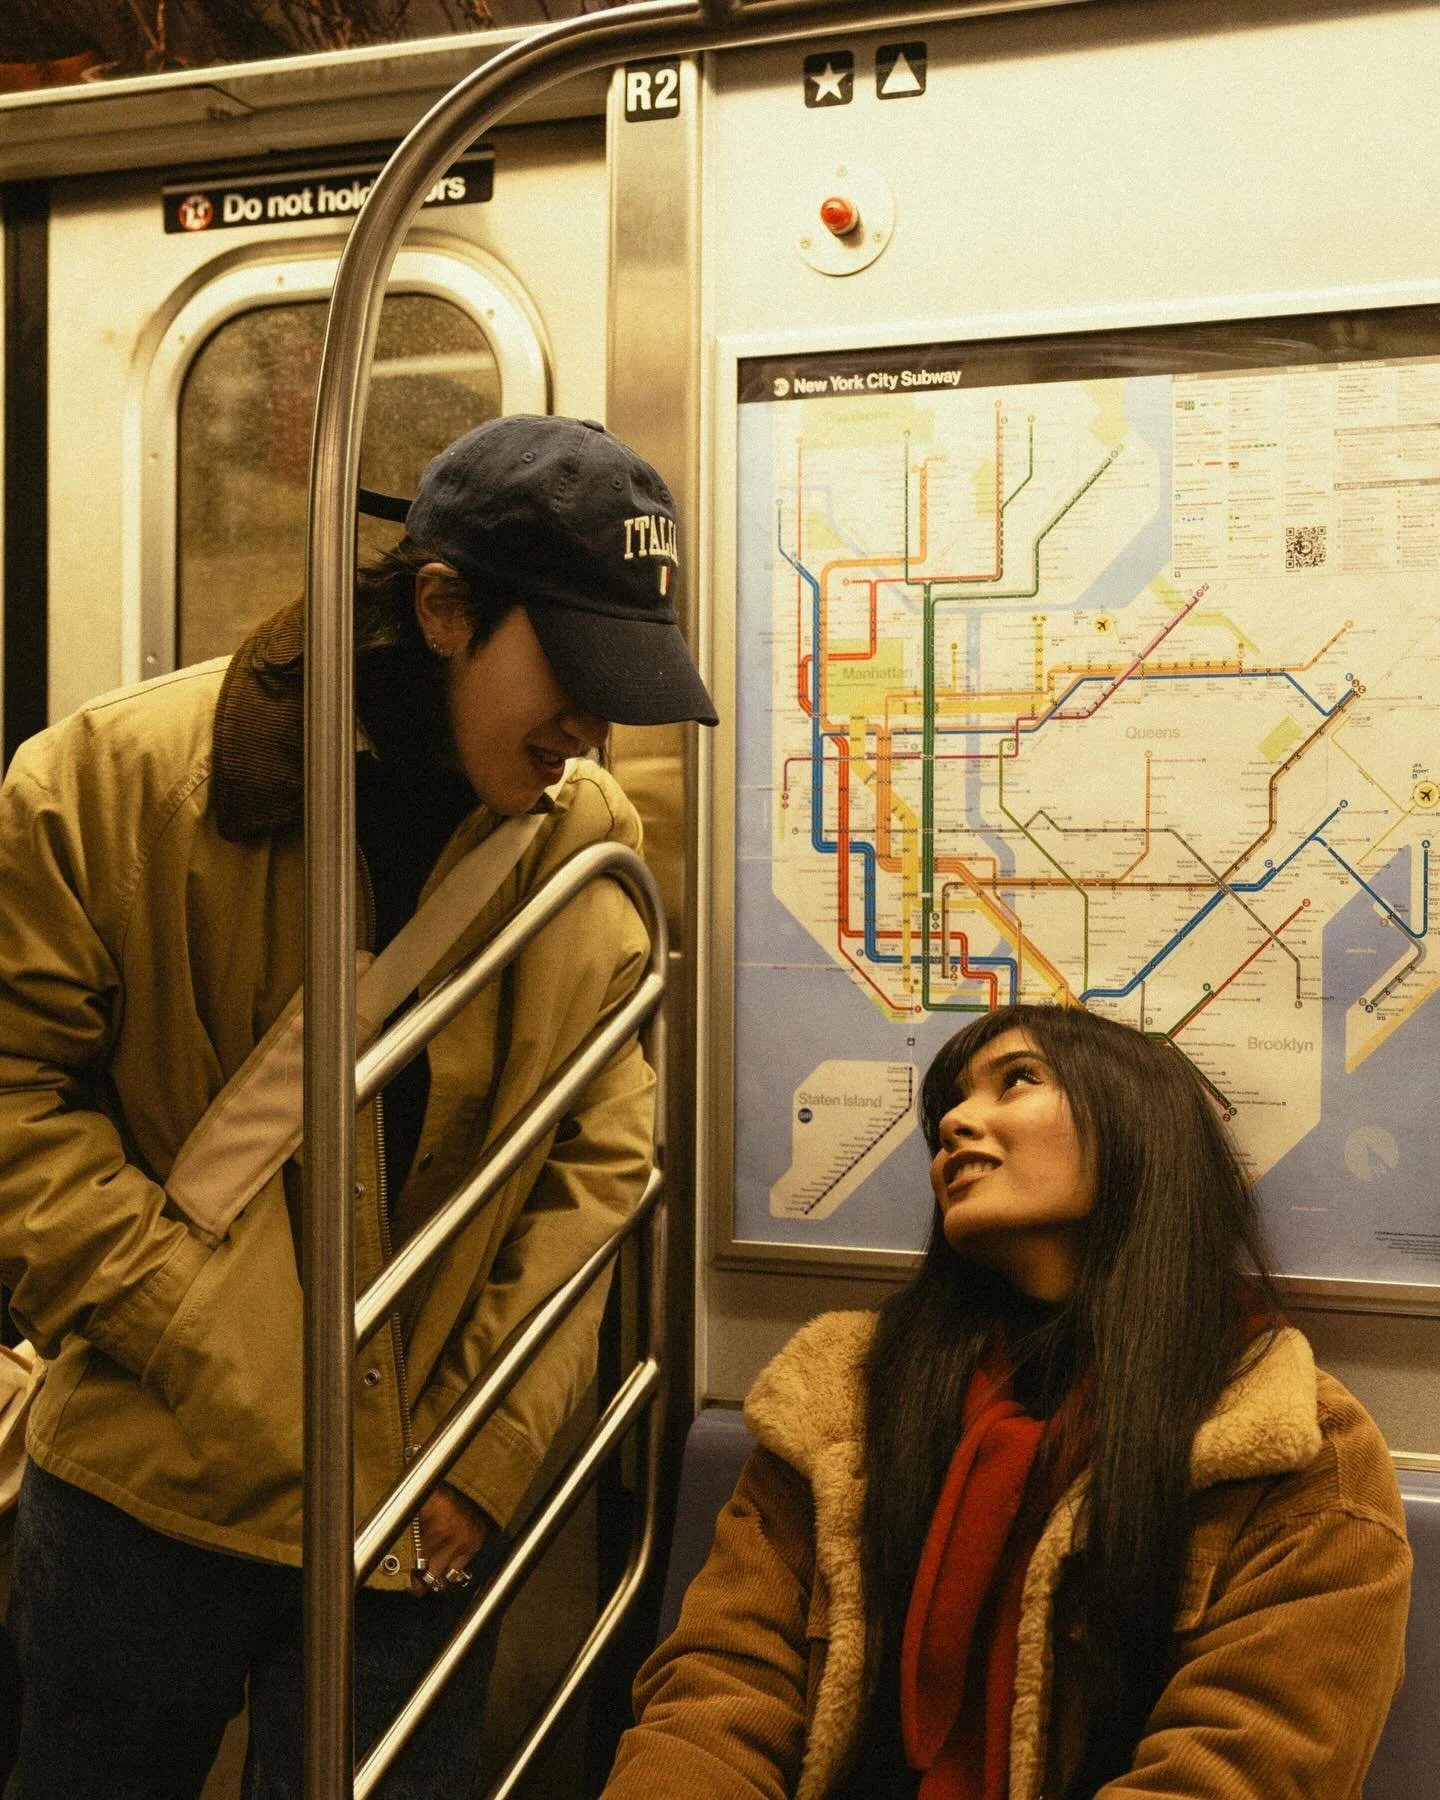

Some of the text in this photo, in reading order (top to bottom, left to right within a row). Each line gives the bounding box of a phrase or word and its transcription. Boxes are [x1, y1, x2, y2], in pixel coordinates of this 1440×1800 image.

[627, 68, 678, 112] R2
[222, 194, 263, 223] Do
[267, 192, 314, 218] not
[793, 378, 828, 394] New
[829, 375, 865, 391] York
[866, 373, 899, 390] City
[900, 369, 962, 387] Subway
[624, 515, 679, 567] ITALI
[842, 667, 913, 680] Manhattan
[1126, 727, 1181, 739] Queens
[1247, 1037, 1314, 1053] Brooklyn
[799, 1093, 882, 1108] Staten Island
